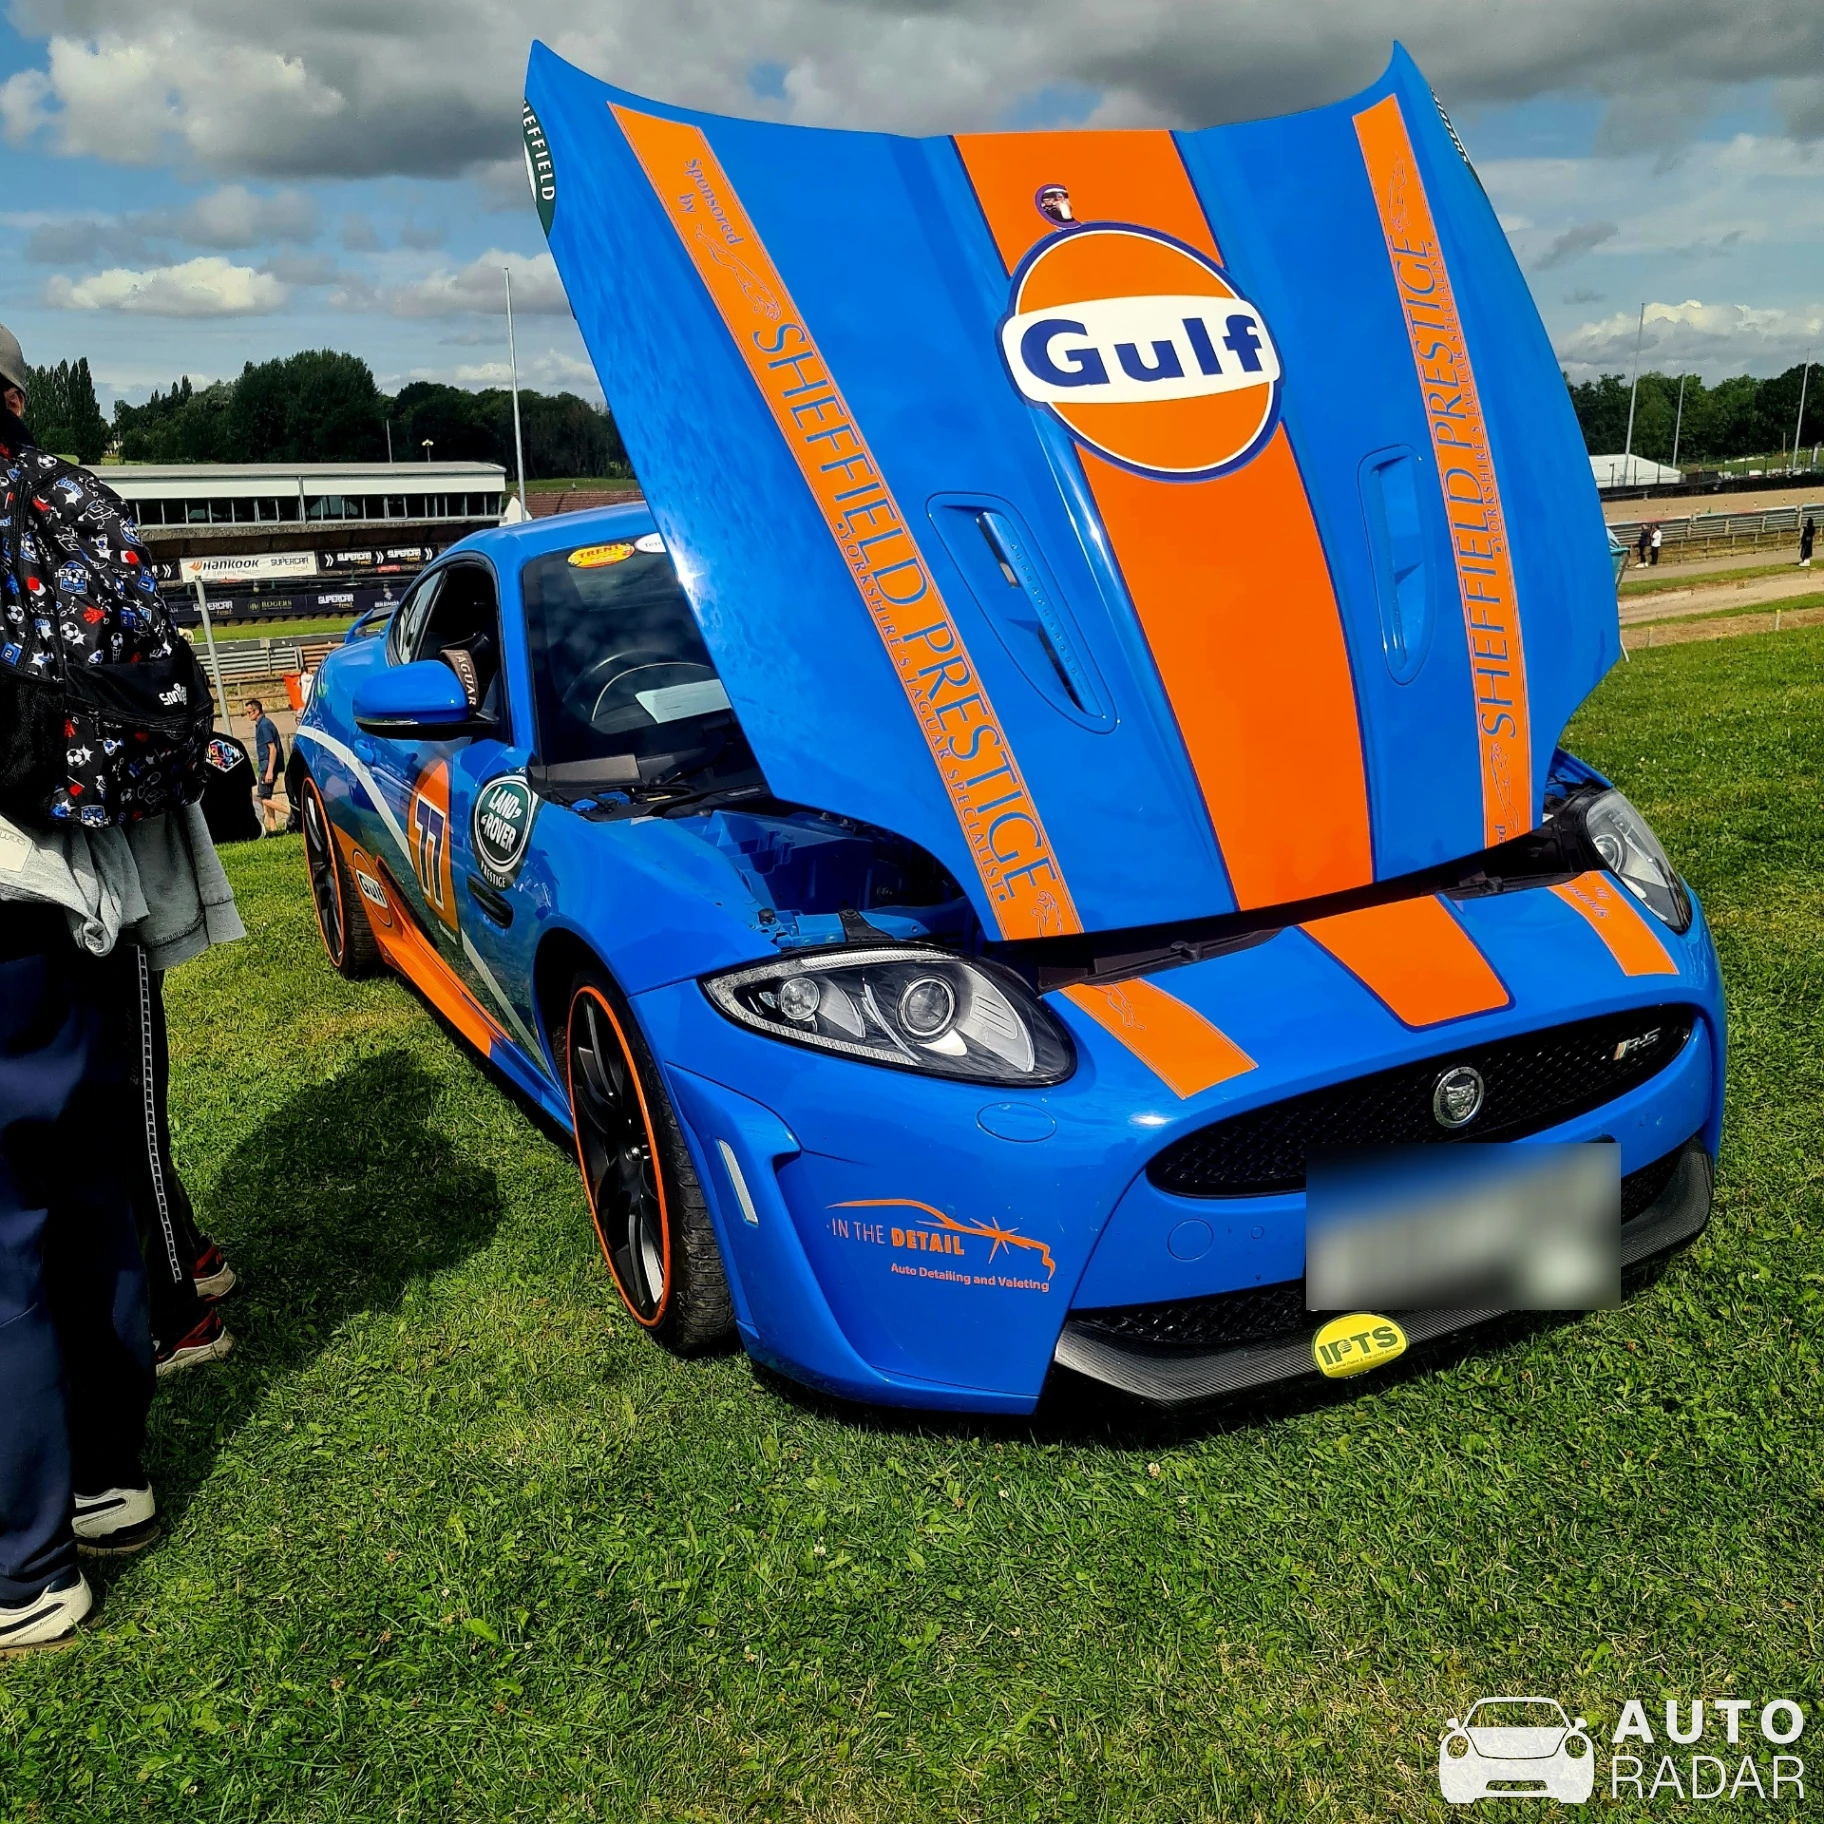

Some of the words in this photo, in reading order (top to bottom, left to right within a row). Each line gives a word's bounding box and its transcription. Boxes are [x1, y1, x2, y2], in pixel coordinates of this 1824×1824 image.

[678, 193, 697, 213] by
[685, 158, 744, 245] Sponsored
[1020, 314, 1263, 388] Gulf
[1388, 234, 1473, 449] PRESTIGE
[1453, 351, 1479, 417] JAGUAR
[56, 477, 84, 499] GOAL
[387, 548, 422, 559] SUPERCAR
[579, 544, 620, 559] TRENT
[752, 323, 928, 605] SHEFFIELD
[902, 621, 1057, 898] PRESTIGE
[1444, 467, 1517, 739] SHEFFIELD
[839, 531, 912, 668] YORKSHIRE'S
[904, 678, 951, 760] JAGUAR
[946, 769, 1005, 889] SPECIALIST
[488, 786, 520, 820] LAND
[415, 792, 447, 911] 77
[484, 812, 517, 853] ROVER
[480, 861, 506, 888] PRESTIGE
[831, 1218, 849, 1239] IN
[853, 1221, 886, 1245] THE
[891, 1227, 965, 1256] DETAIL
[891, 1263, 917, 1277] Auto
[919, 1266, 971, 1285] Detailing
[973, 1275, 996, 1286] and
[998, 1276, 1050, 1293] Valeting
[1318, 1325, 1399, 1366] IPTS
